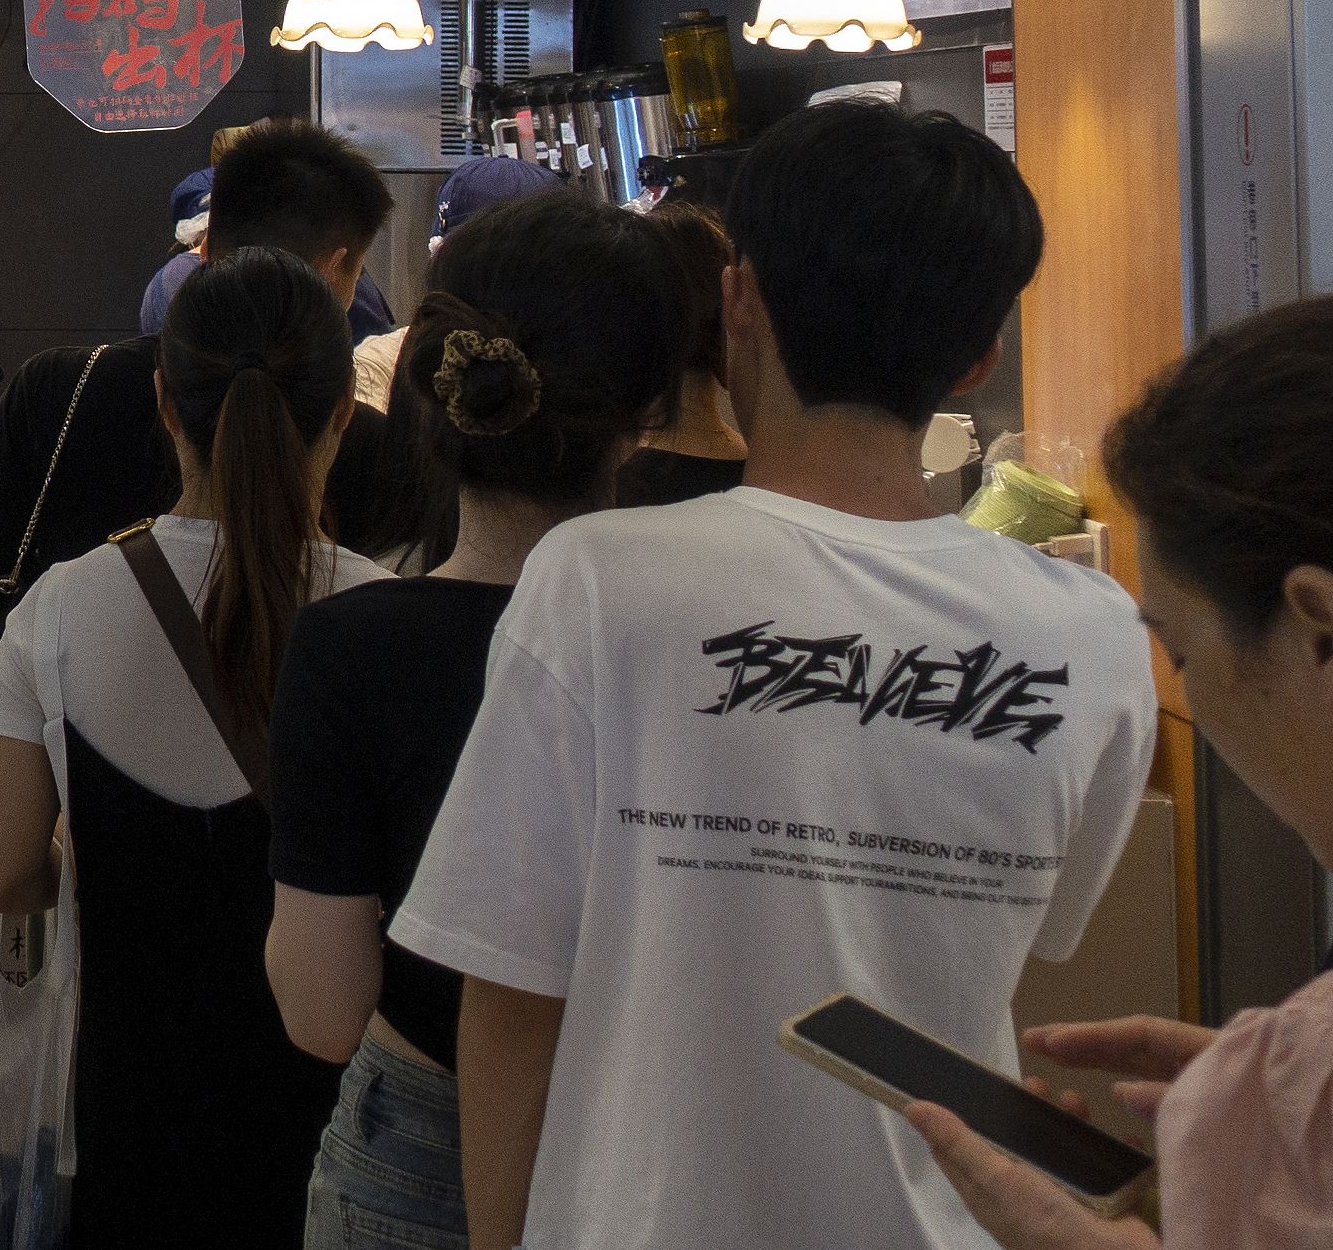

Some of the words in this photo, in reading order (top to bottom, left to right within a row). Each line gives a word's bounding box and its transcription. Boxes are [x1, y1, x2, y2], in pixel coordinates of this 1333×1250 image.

[618, 809, 645, 825] THE
[649, 812, 687, 829] NEW
[692, 814, 752, 833] TREND
[757, 819, 781, 836] OF
[848, 831, 952, 860] SUBVERSION
[954, 845, 976, 862] OF
[750, 848, 808, 864] SURROUND
[704, 860, 765, 874] ENCOURAGE
[767, 864, 795, 878] YOUR
